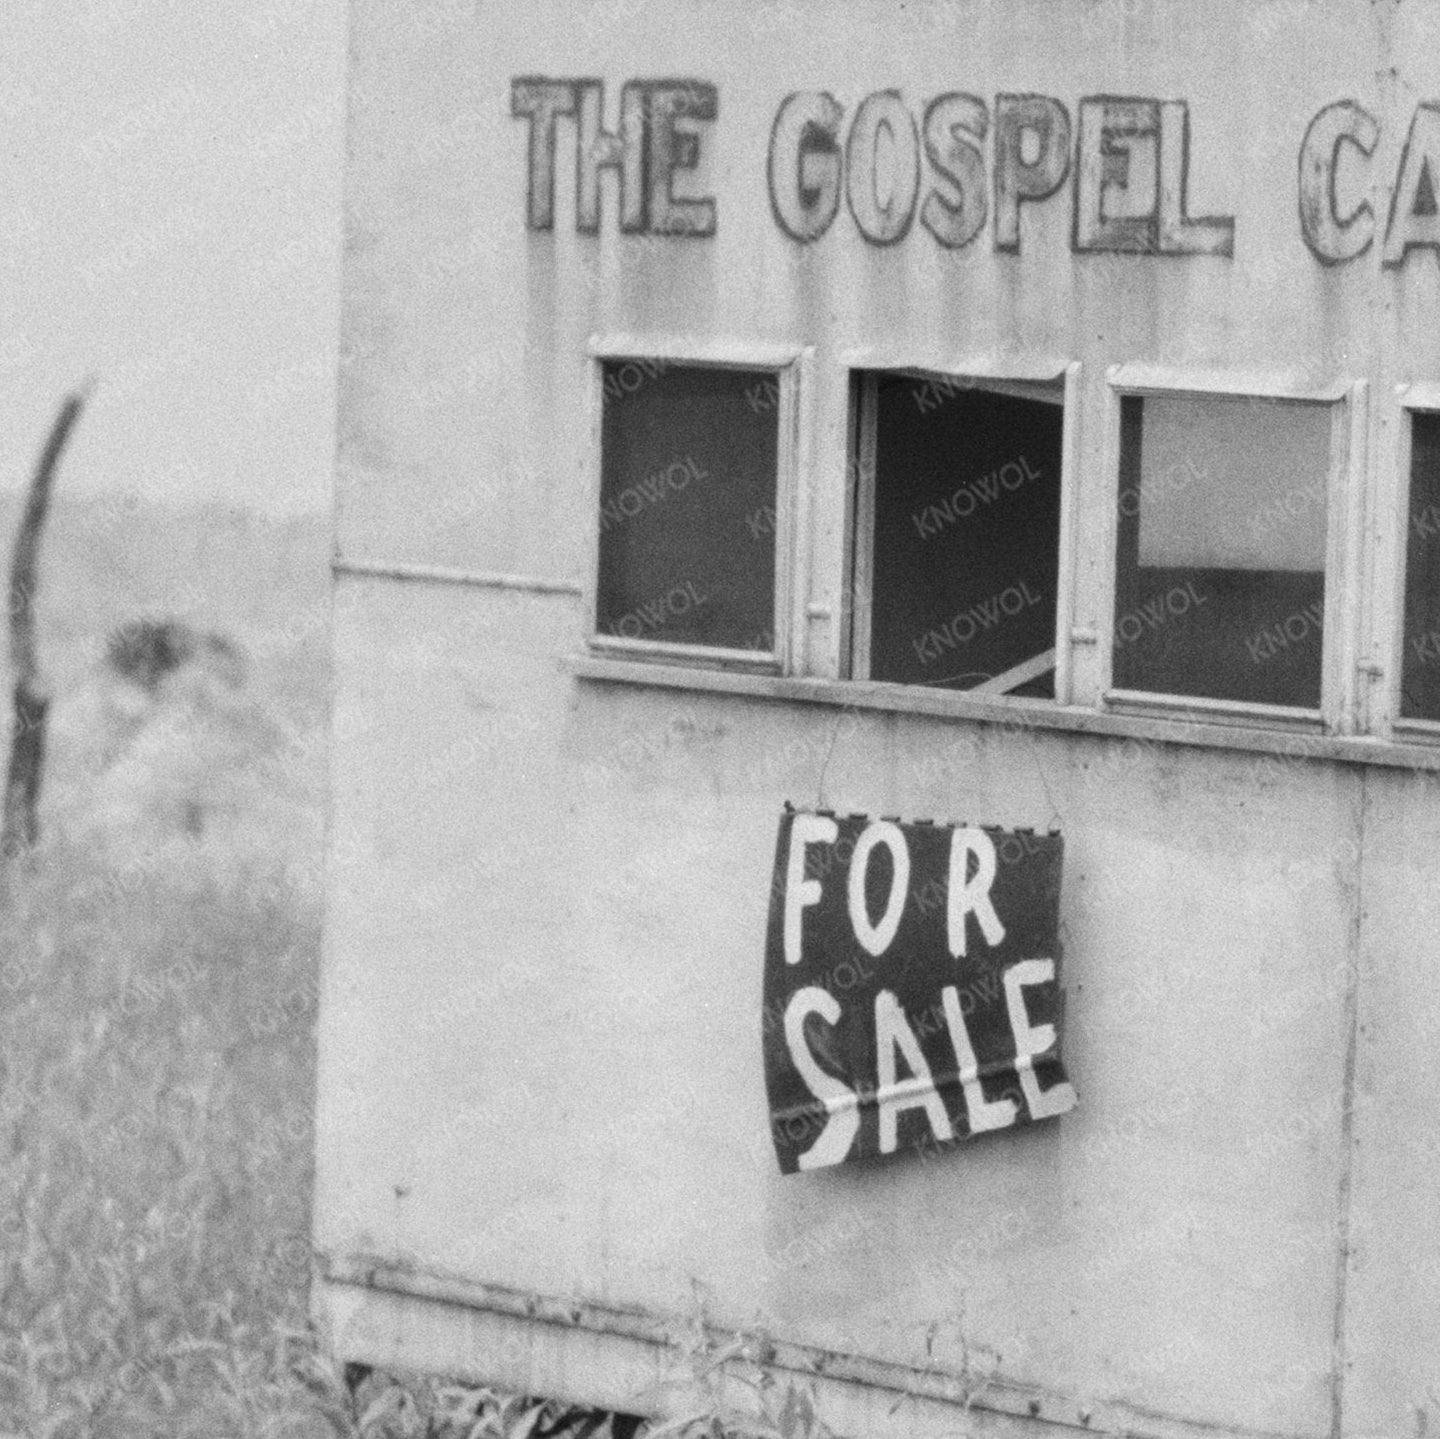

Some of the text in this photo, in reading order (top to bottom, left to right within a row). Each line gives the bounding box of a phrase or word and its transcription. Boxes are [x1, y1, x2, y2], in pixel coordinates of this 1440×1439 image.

[511, 77, 718, 236] THE
[768, 89, 1234, 255] GOSPEL
[784, 814, 1006, 964] FOR
[784, 958, 1078, 1171] SALE
